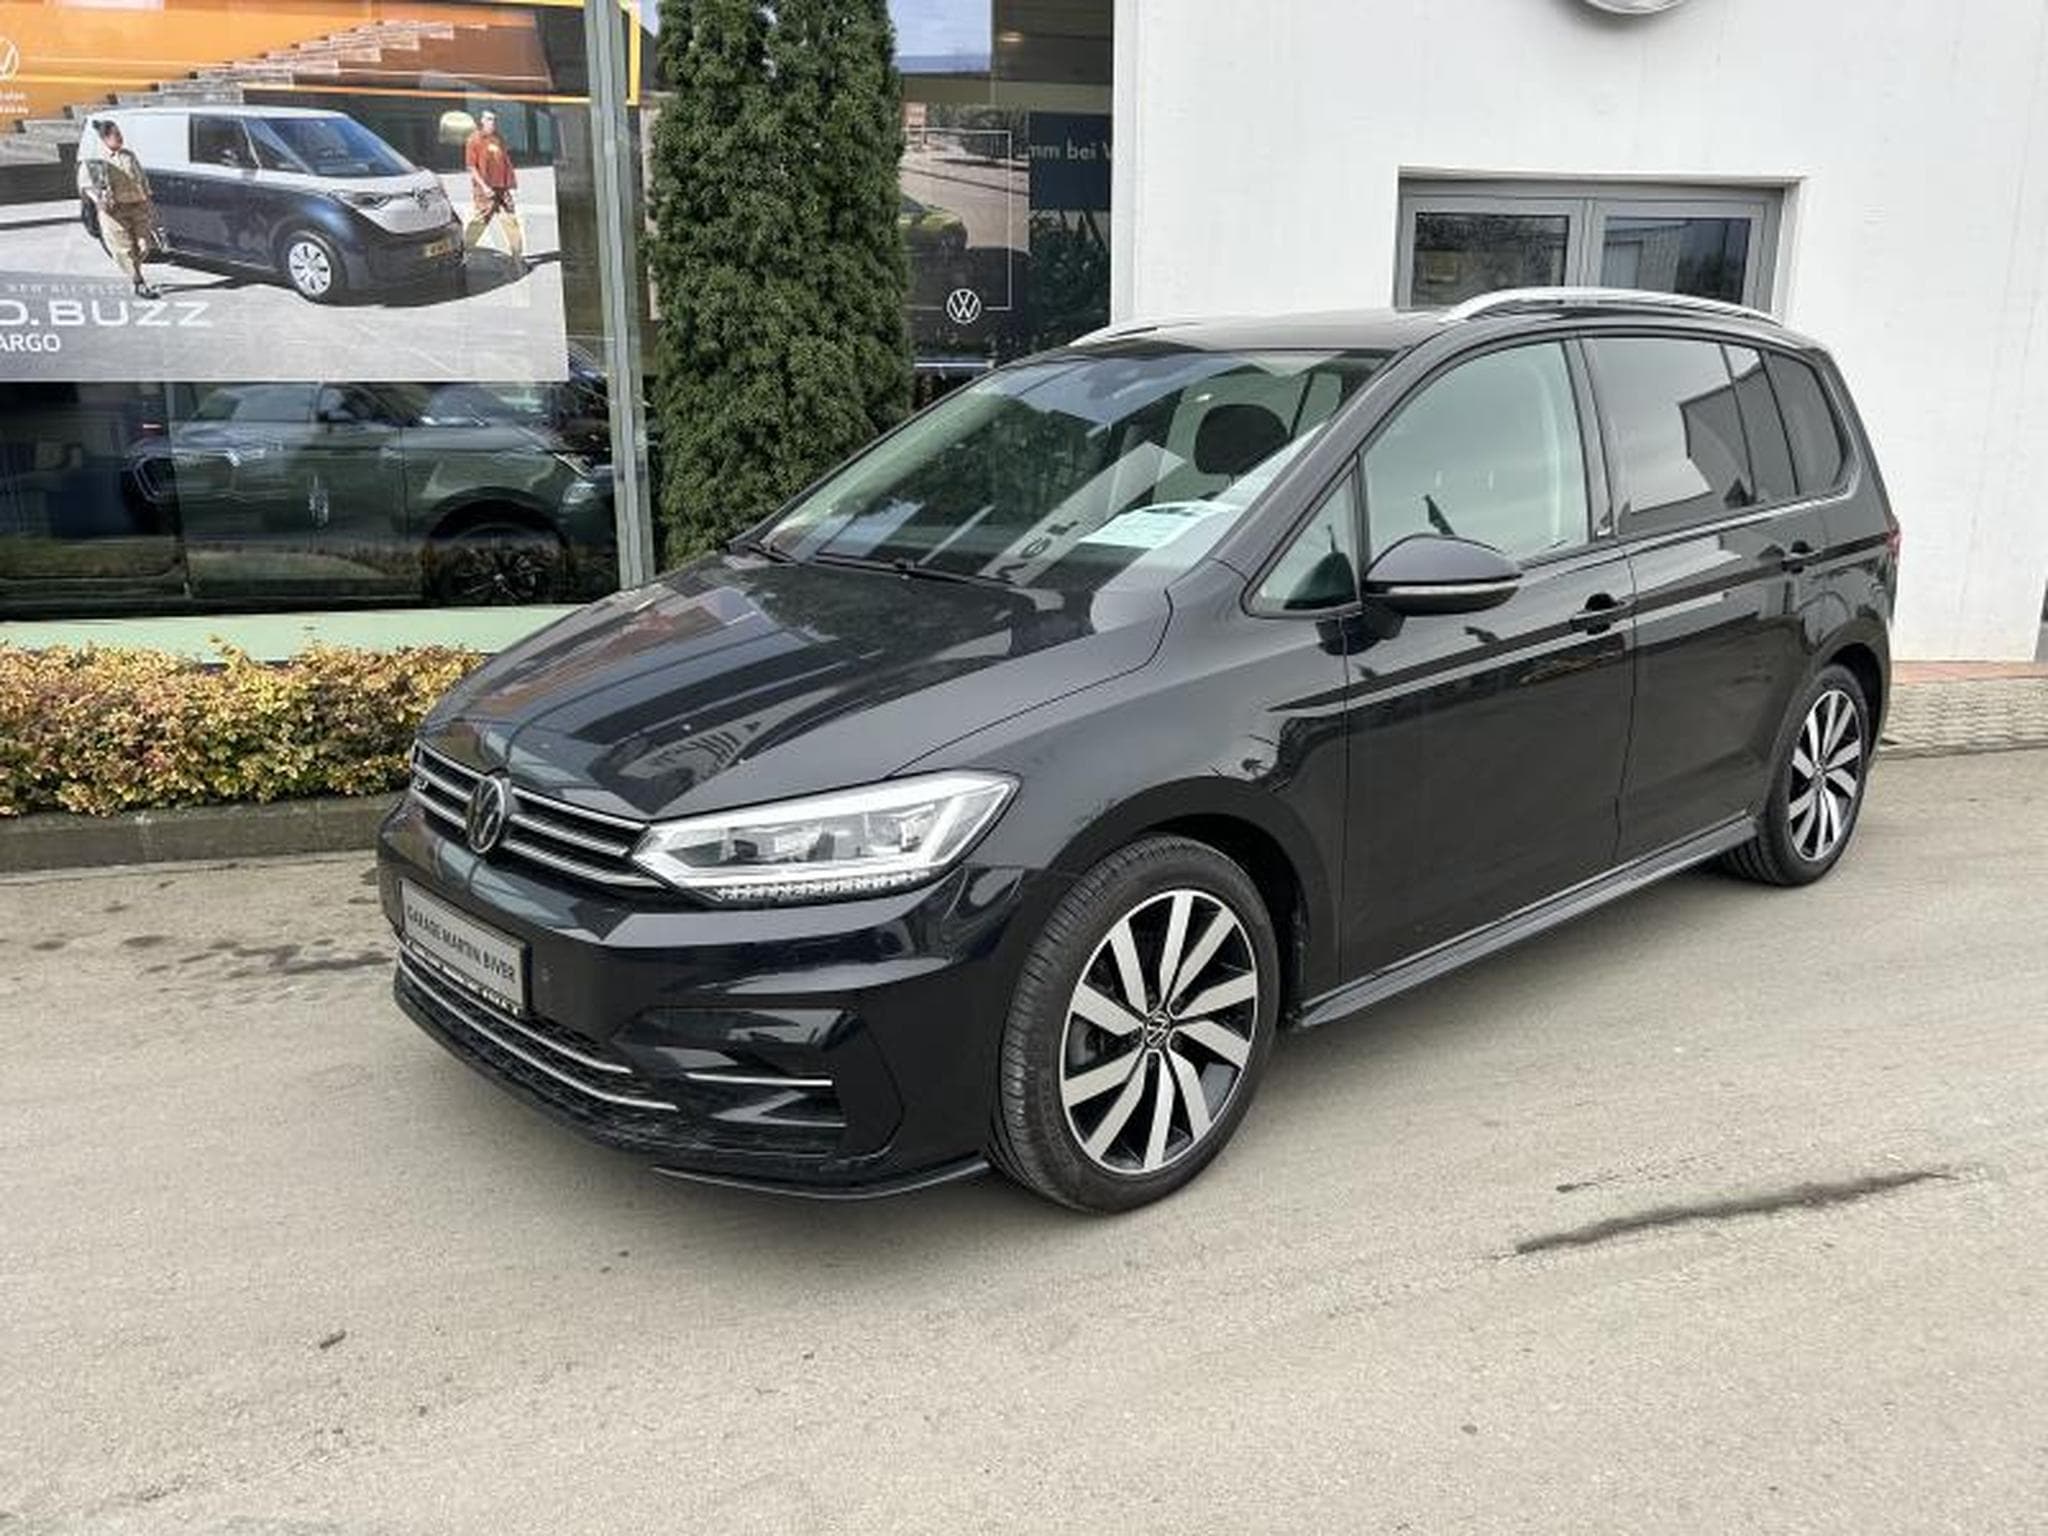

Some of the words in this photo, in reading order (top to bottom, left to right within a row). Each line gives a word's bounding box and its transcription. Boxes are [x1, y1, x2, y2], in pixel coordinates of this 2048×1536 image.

[1067, 137, 1097, 159] bei
[49, 300, 213, 327] BUZZ
[946, 288, 981, 323] VW
[442, 928, 482, 965] MARTIN
[483, 951, 516, 984] BIVER
